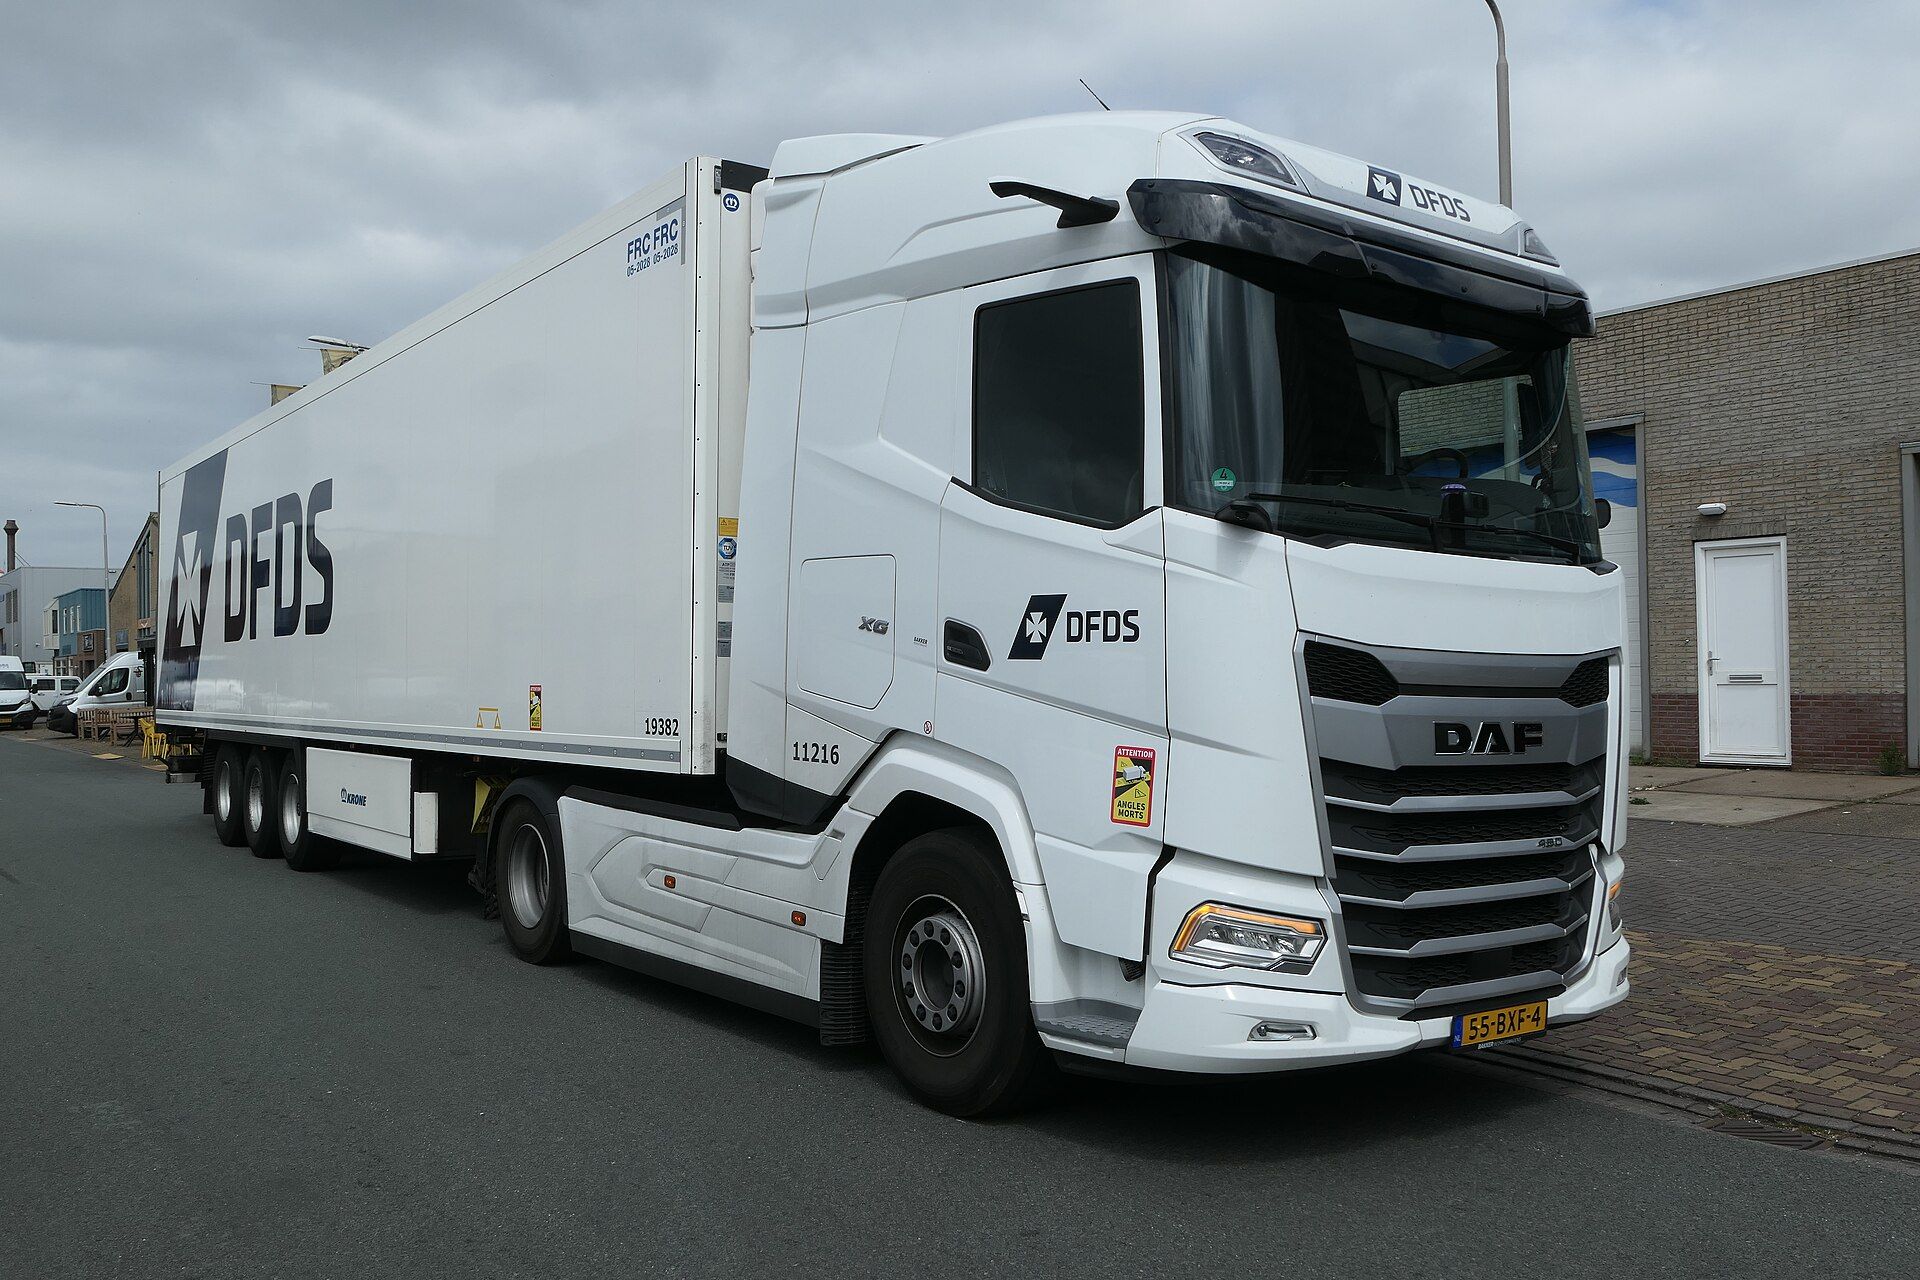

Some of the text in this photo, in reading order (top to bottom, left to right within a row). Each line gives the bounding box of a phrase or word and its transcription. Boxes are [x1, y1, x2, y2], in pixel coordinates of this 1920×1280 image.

[1408, 184, 1471, 222] DFDS
[627, 218, 679, 263] FRC FRC
[626, 244, 679, 277] 05-2028 05-2028
[1219, 468, 1228, 480] 4
[224, 478, 334, 643] DFDS
[858, 616, 889, 635] XG
[1066, 609, 1140, 643] DFDS
[645, 717, 679, 736] 19382
[1433, 721, 1543, 756] DAF
[792, 741, 840, 765] 11216
[1117, 748, 1153, 759] ATTENTION
[346, 792, 367, 807] KRONE
[1117, 800, 1146, 811] ANGLES
[1117, 808, 1144, 819] MORTS
[1468, 1006, 1541, 1041] 55-BXF-4
